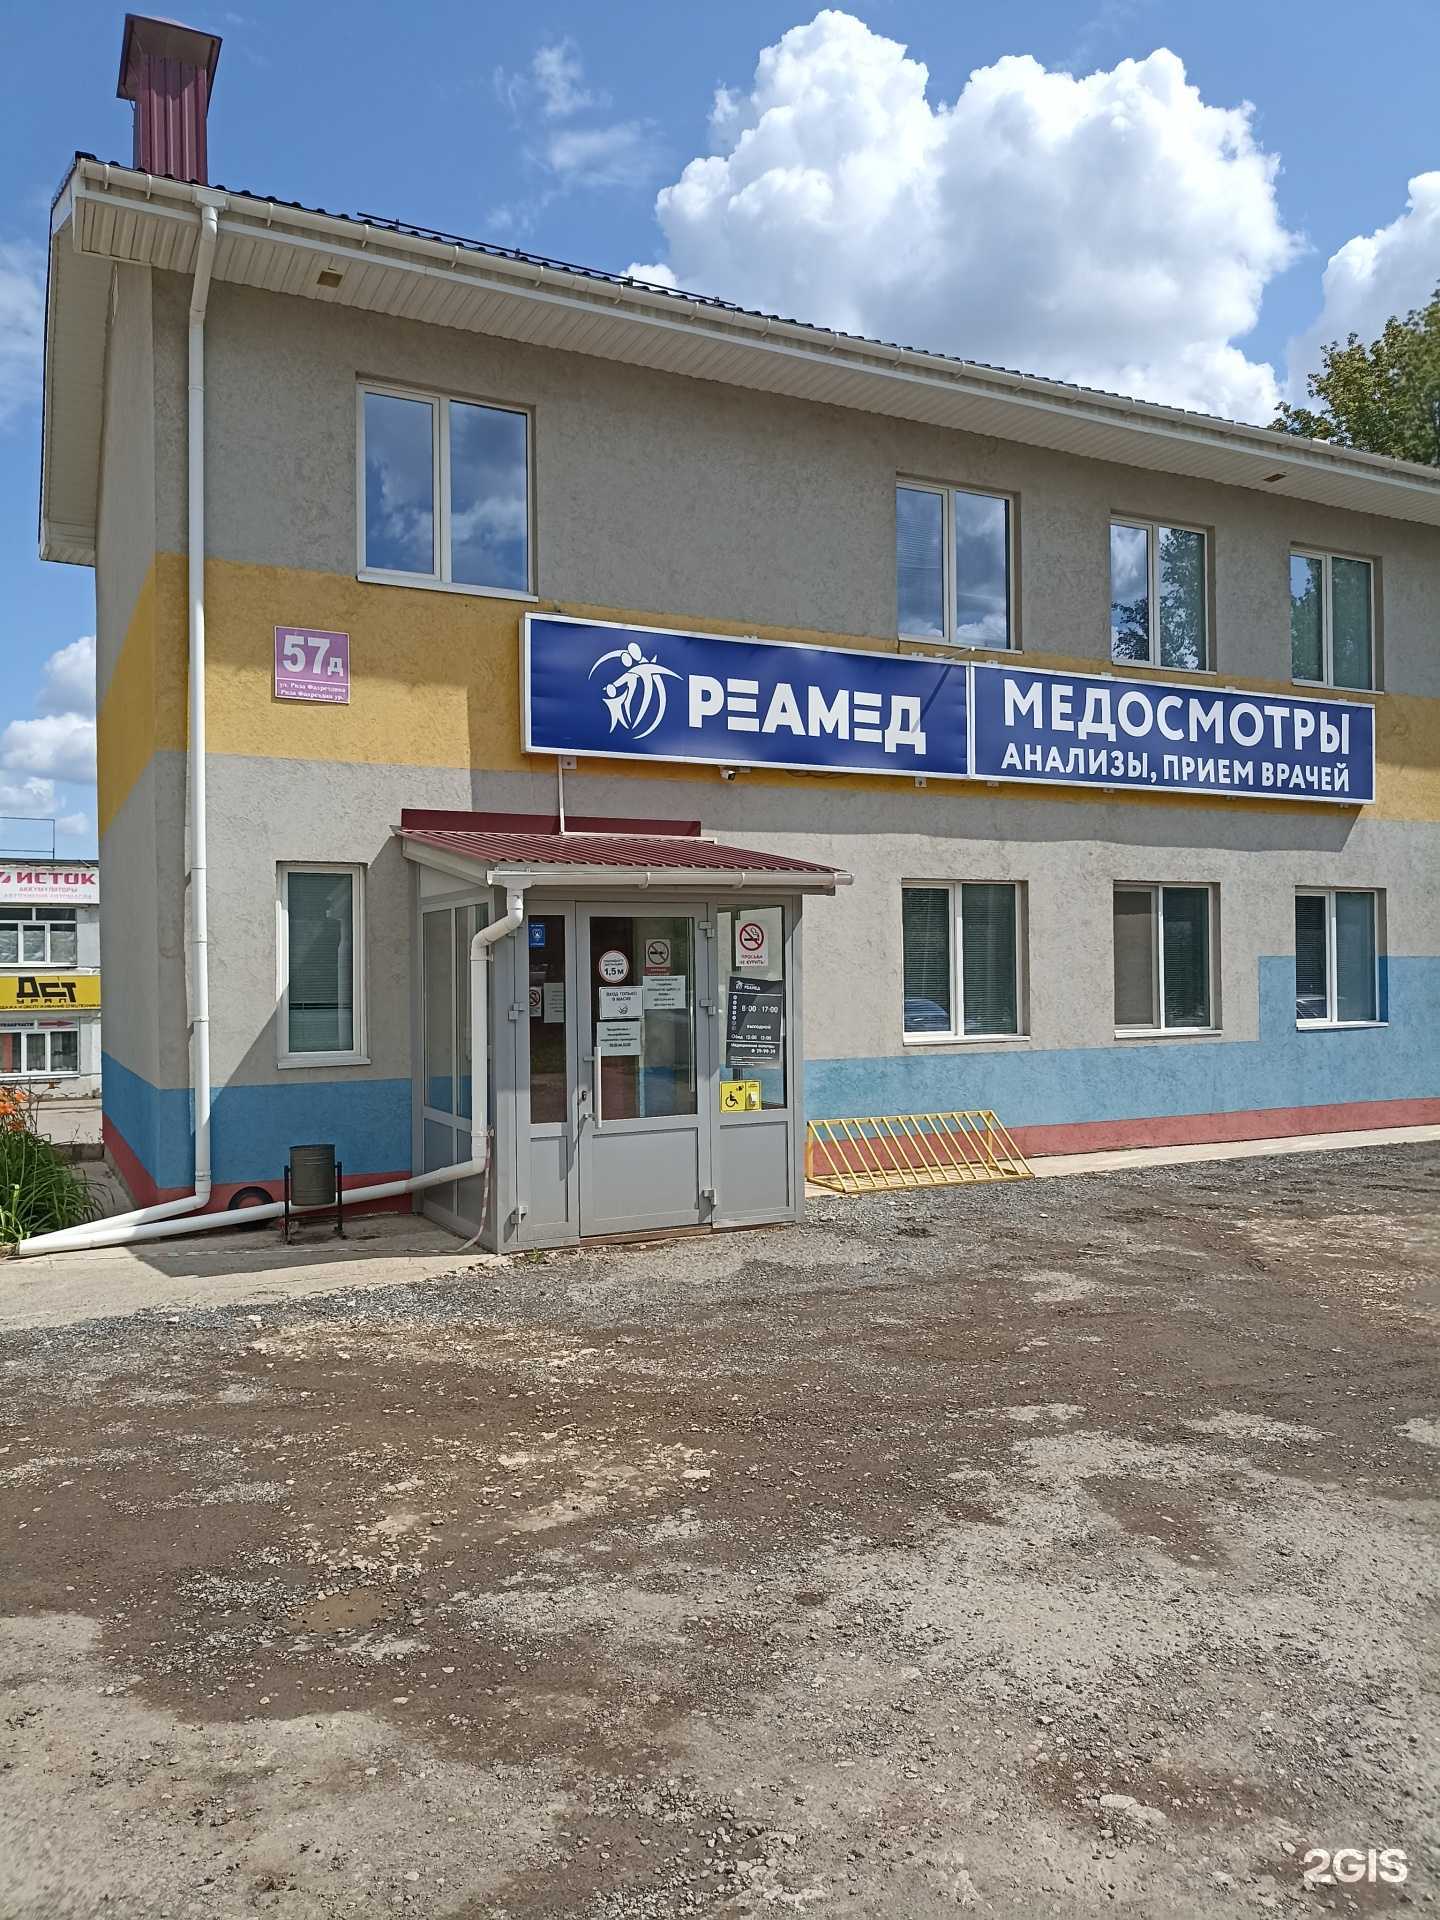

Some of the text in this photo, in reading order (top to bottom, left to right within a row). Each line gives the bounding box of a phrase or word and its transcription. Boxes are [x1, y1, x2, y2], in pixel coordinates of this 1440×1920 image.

[688, 674, 927, 755] РЕАМЕД
[1004, 678, 1350, 755] МЕДОСМОТРЫ
[1001, 742, 1350, 793] АНАЛИЗЫ, ПРИЕМ ВРАЧЕЙ
[16, 871, 96, 885] ИСТОК
[16, 976, 77, 1003] ДСТ
[604, 967, 617, 976] 1,5
